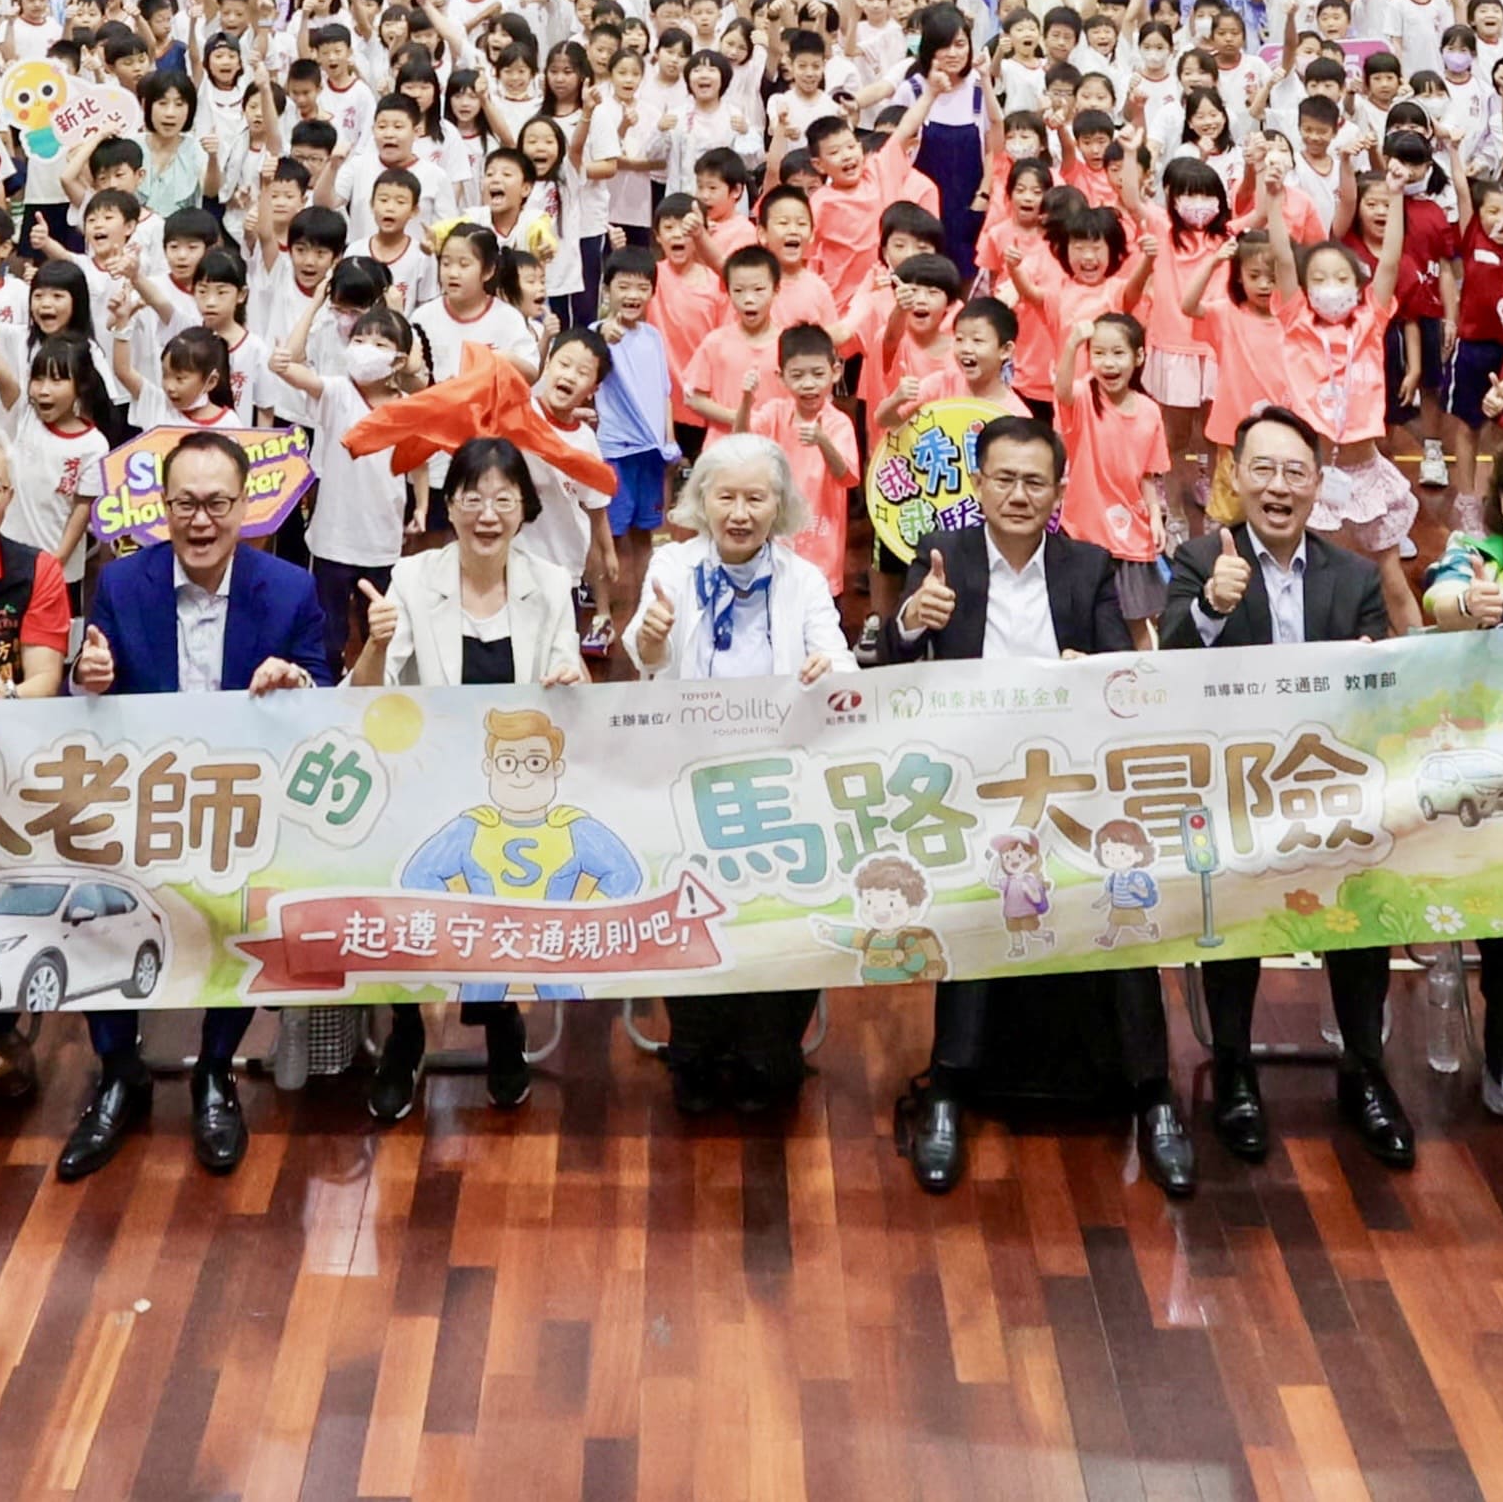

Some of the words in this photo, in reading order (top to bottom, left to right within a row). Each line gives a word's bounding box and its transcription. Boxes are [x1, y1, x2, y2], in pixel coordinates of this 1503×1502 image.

[55, 97, 100, 133] 新北
[246, 426, 307, 463] mart
[98, 485, 166, 534] Sho
[681, 691, 723, 701] TOYOTA
[928, 685, 1071, 709] 和泰純青基金會
[1203, 682, 1266, 698] 指導單位/
[1276, 676, 1330, 694] 交通部
[1344, 671, 1397, 692] 教育部
[609, 713, 671, 727] 主辦單位/
[680, 698, 793, 725] mobility
[712, 727, 780, 737] FOUNDATION
[689, 732, 1386, 885] 馬路大冒險
[501, 837, 542, 887] S
[299, 909, 692, 962] 一起遵守交通規則吧!
